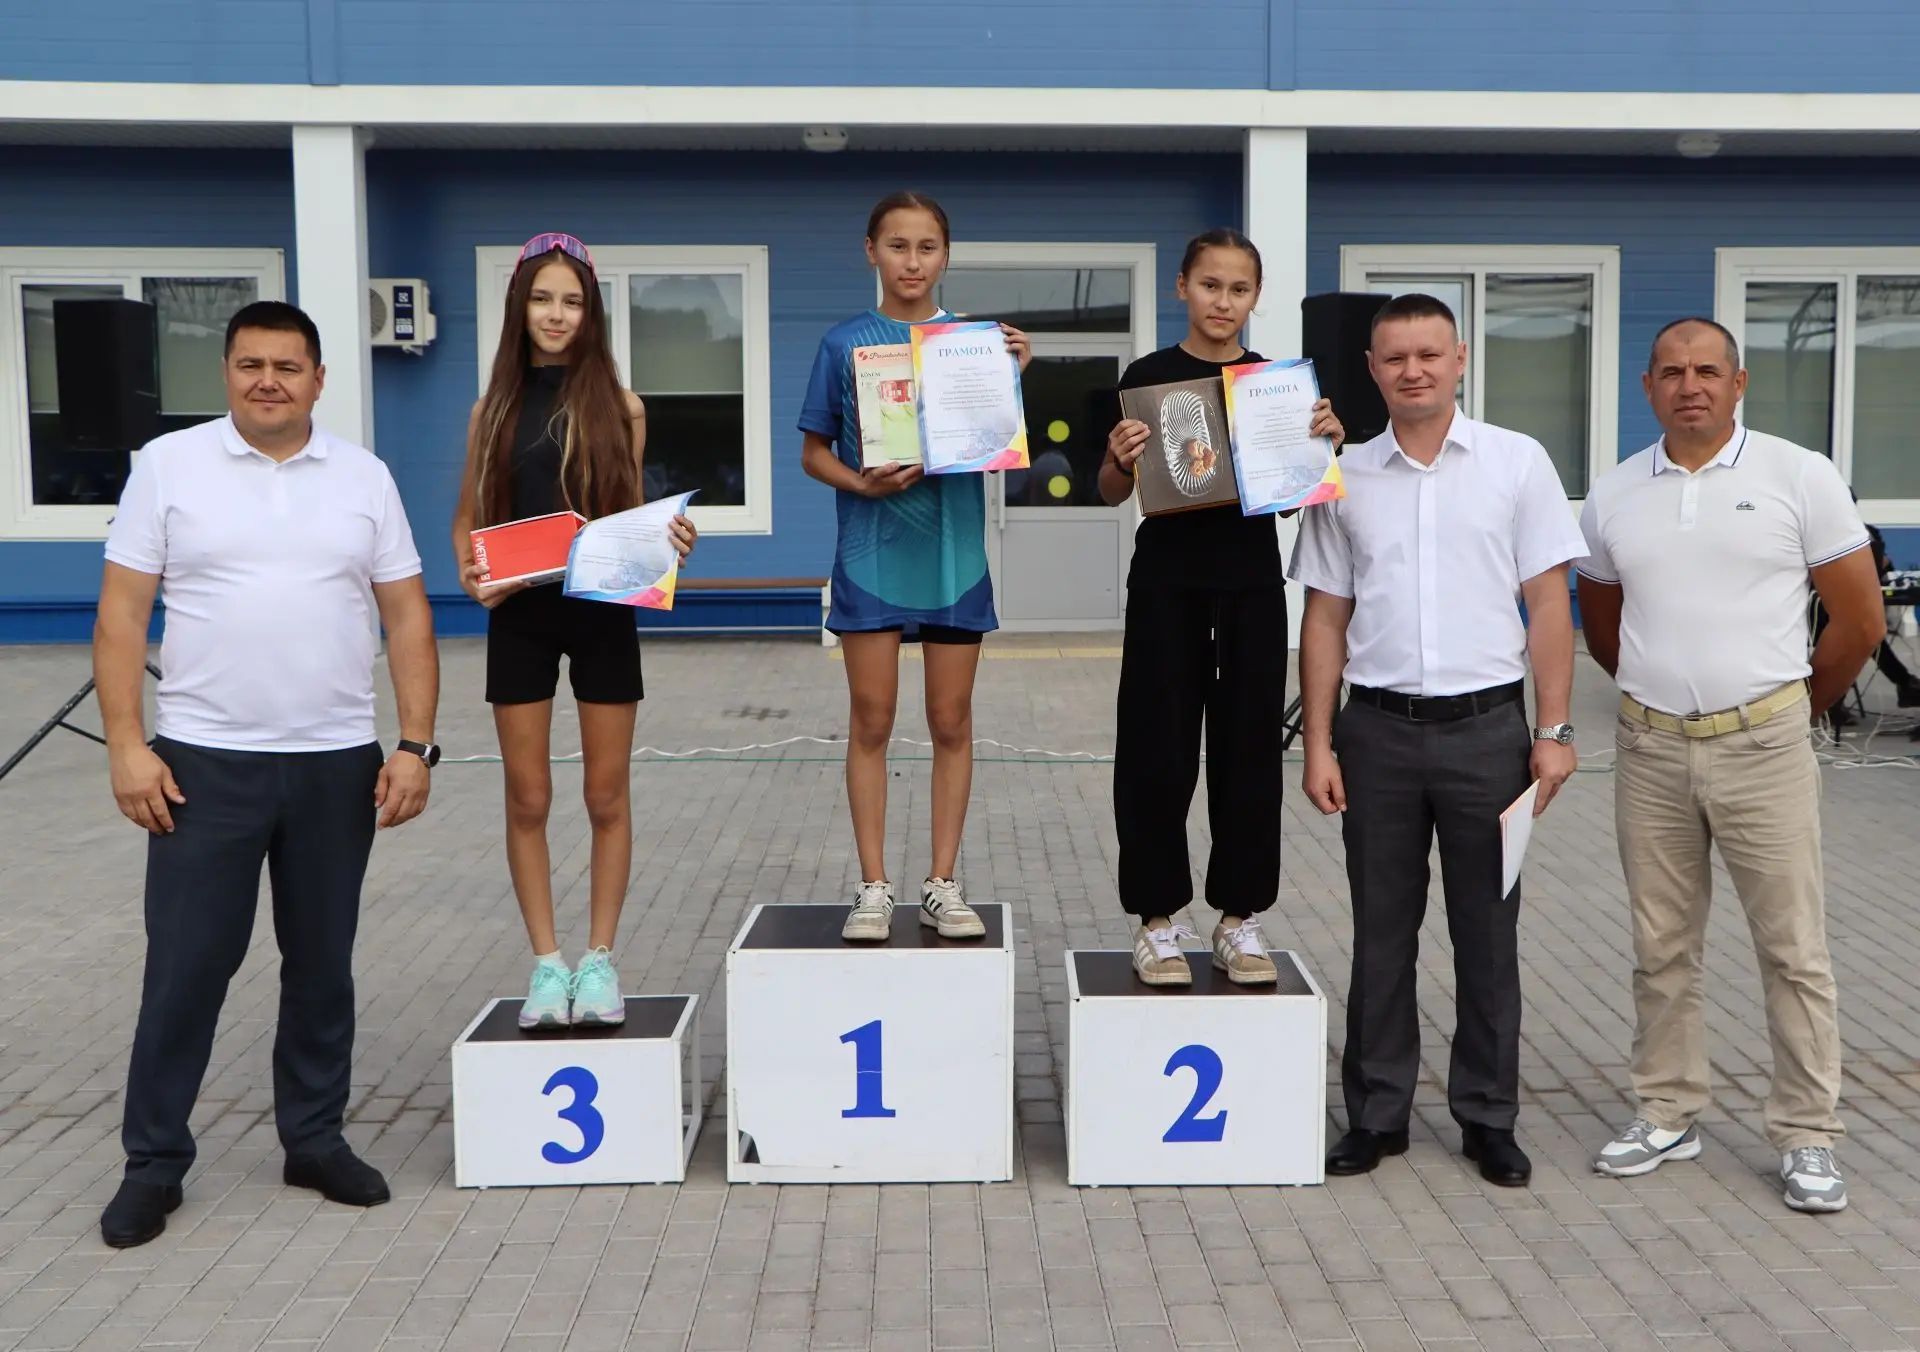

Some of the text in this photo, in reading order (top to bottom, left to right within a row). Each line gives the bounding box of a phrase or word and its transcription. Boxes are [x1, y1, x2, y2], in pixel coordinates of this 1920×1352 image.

[938, 346, 993, 357] ГРАМОТА
[1248, 384, 1299, 398] ГРАМОТА
[541, 1066, 604, 1164] 3
[840, 1019, 896, 1118] 1
[1163, 1044, 1228, 1143] 2
